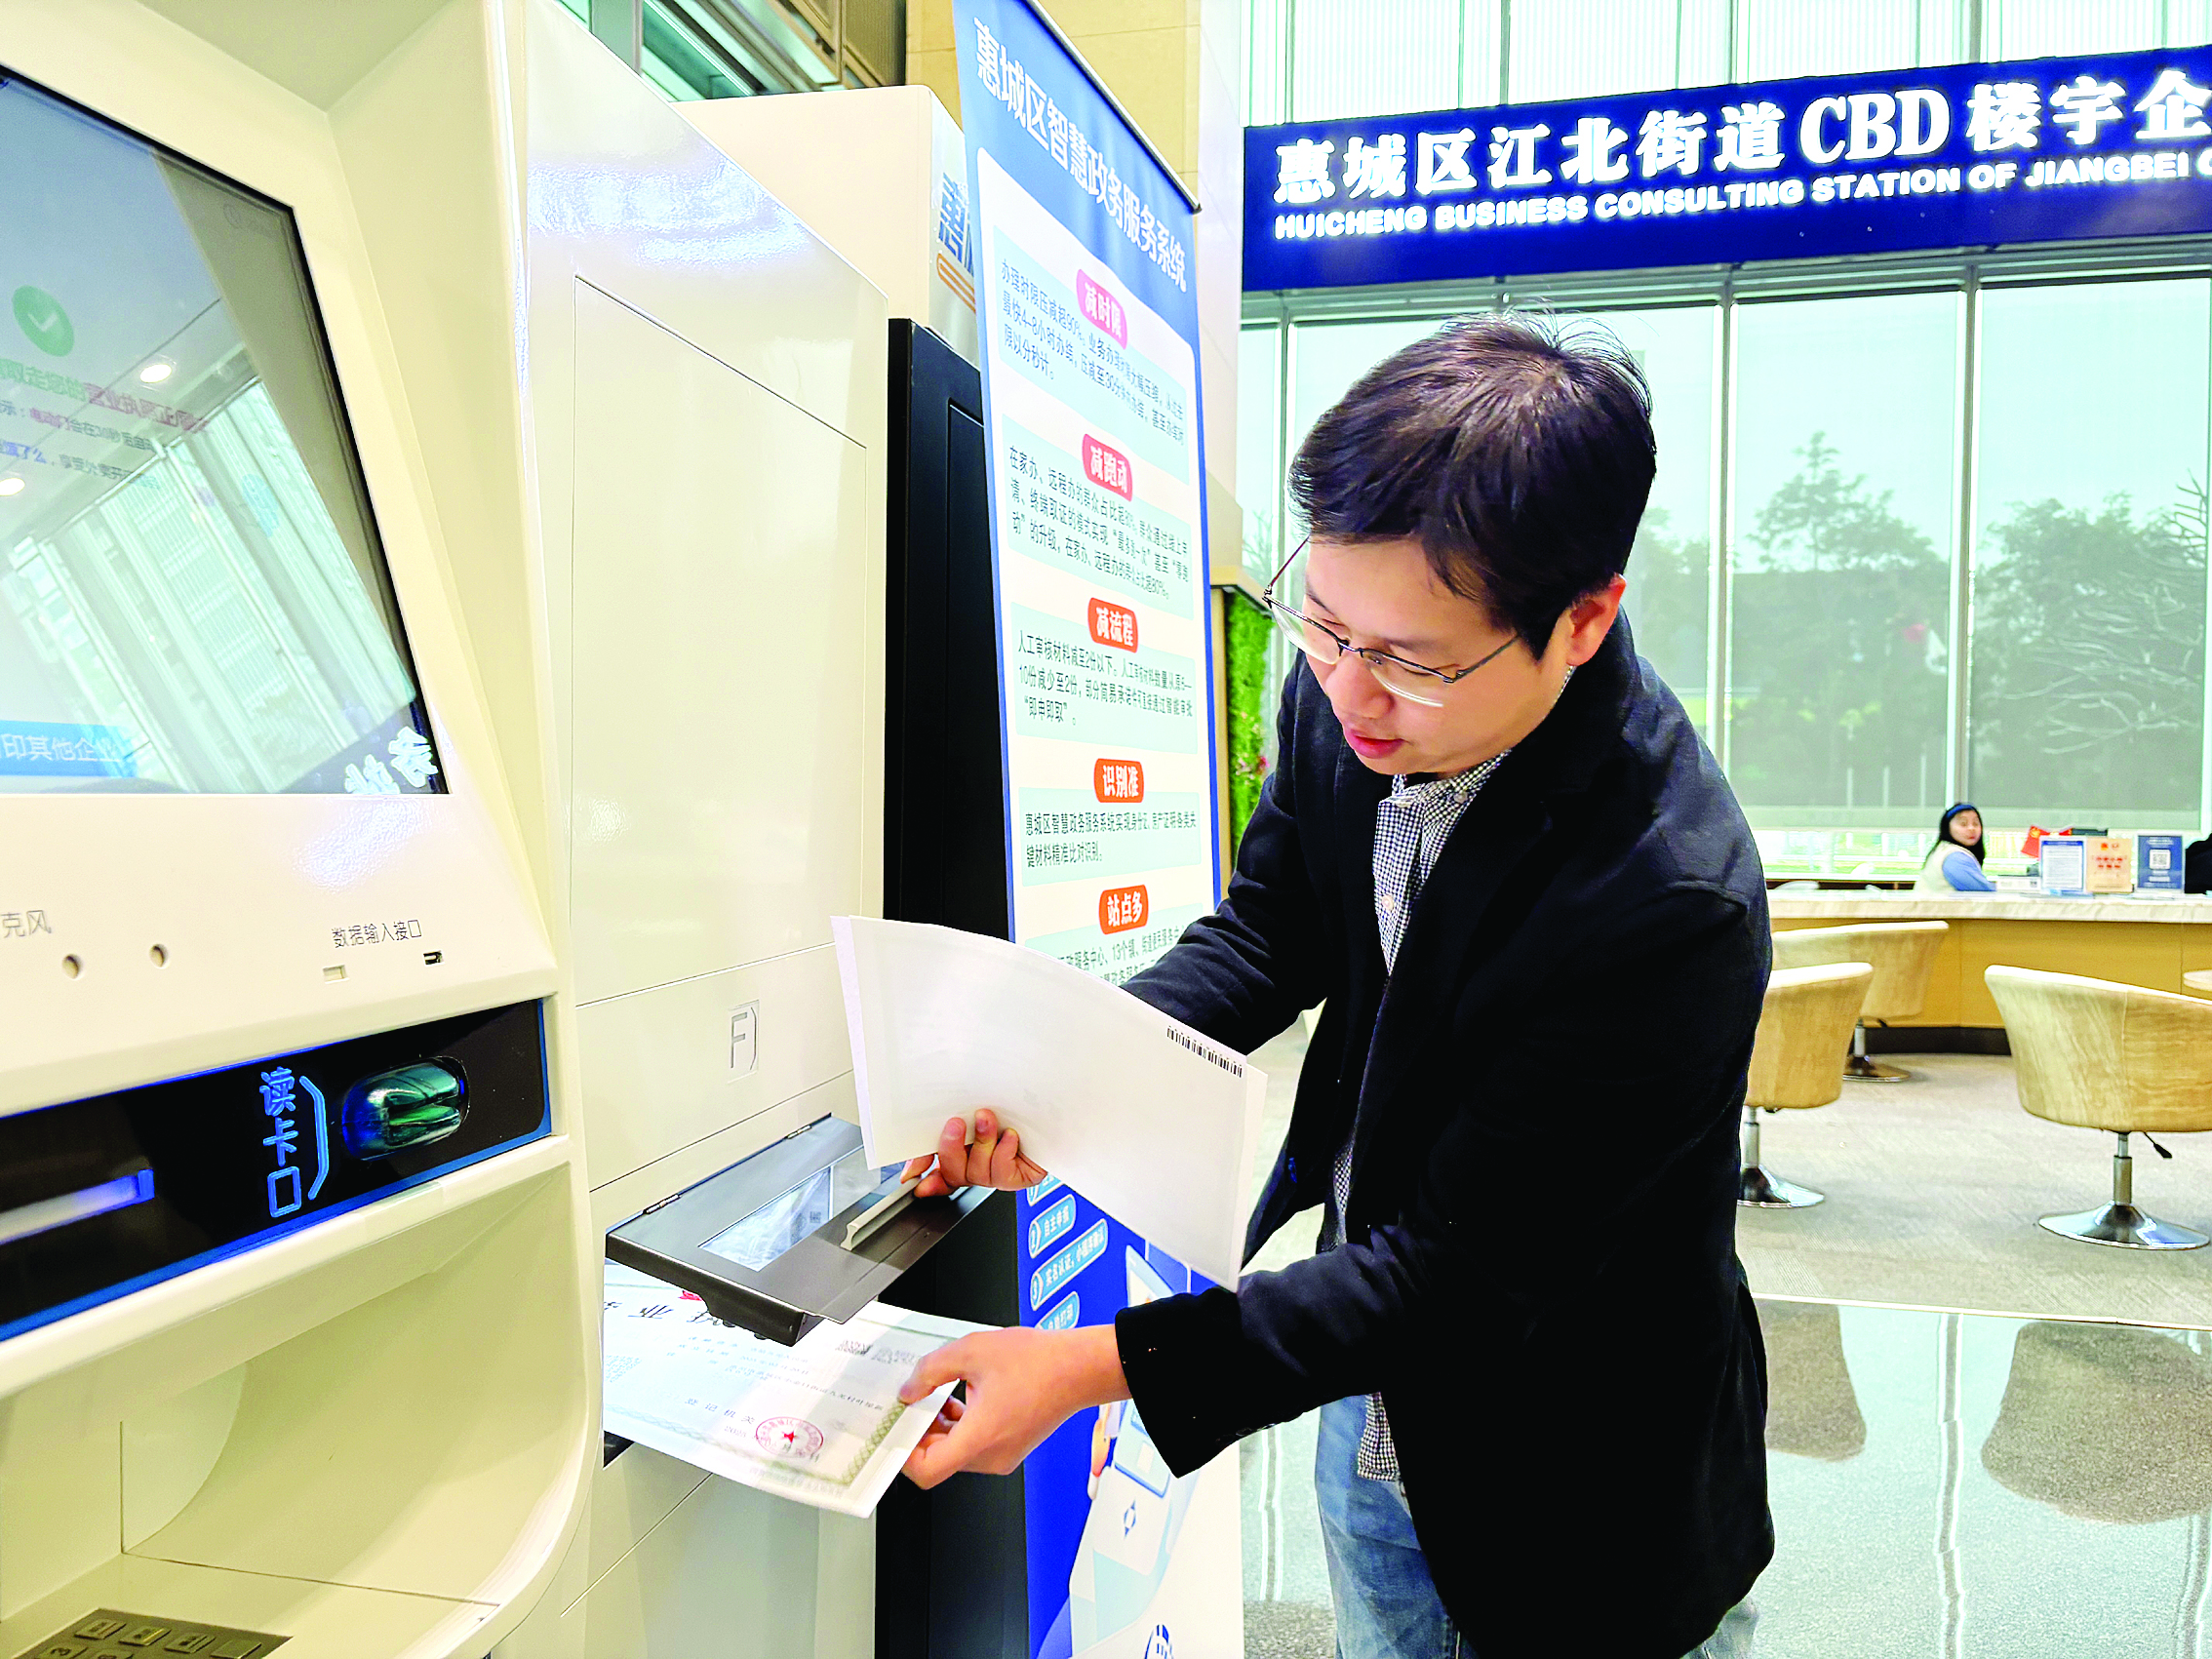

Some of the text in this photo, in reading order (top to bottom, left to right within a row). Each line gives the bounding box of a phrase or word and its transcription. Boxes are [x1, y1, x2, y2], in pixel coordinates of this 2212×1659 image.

[974, 17, 1187, 293] 惠城区智慧政务服务系统
[1274, 205, 1428, 240] HUICHENG
[1434, 195, 1589, 231] BUSINESS
[1594, 178, 1804, 219] CONSULTING
[1811, 167, 1961, 203] STATION
[1967, 162, 2017, 190] OF
[2024, 151, 2190, 188] JIANGBEI
[1084, 280, 1124, 340] 减时限
[1005, 323, 1054, 380] 限以分秒计。
[1089, 444, 1128, 494] 减跑动
[1095, 606, 1134, 647] 减流程
[1102, 765, 1139, 798] 识别准
[0, 909, 53, 939] 克风
[331, 918, 423, 948] 数据输入接口
[1107, 890, 1143, 928] 站点多
[259, 1066, 303, 1219] 读卡口
